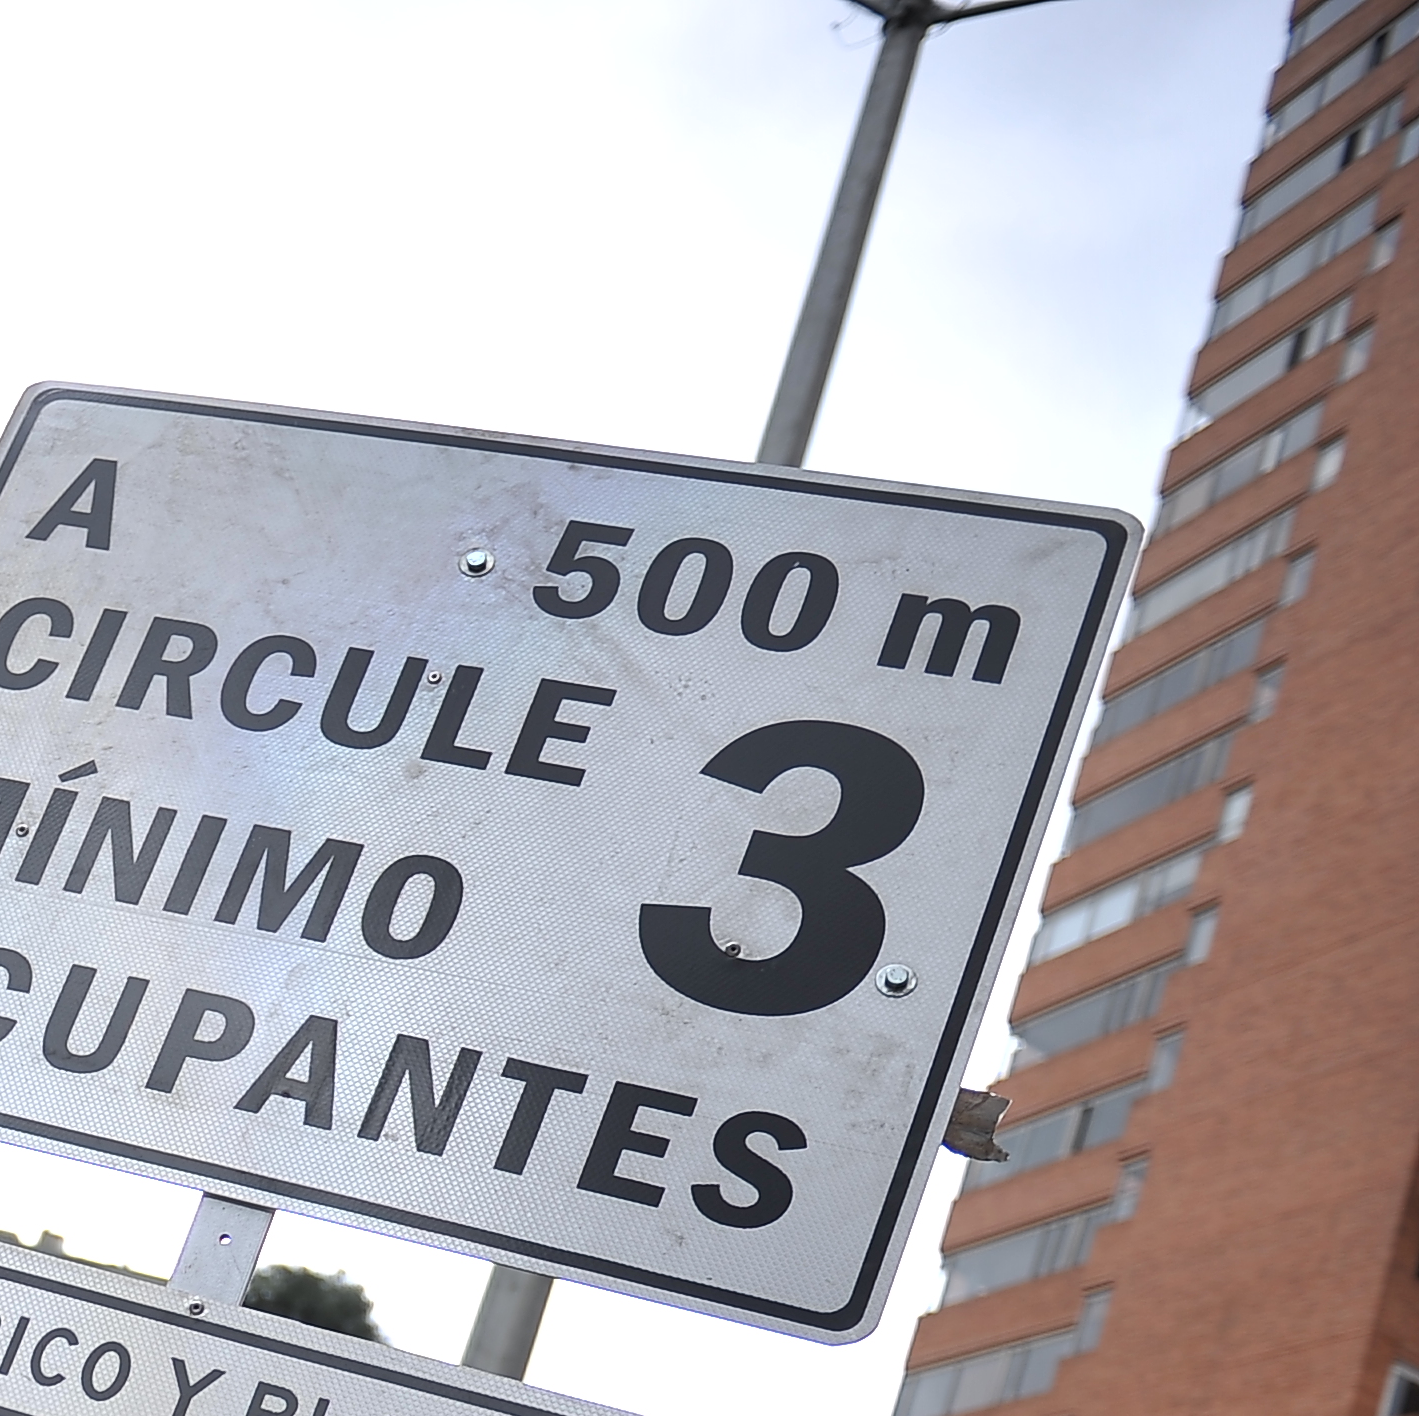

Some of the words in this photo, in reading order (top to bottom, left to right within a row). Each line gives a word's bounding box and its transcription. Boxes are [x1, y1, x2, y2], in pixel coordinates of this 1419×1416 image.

[25, 458, 118, 551] A
[532, 519, 840, 653] 500
[876, 592, 1021, 685] m
[638, 719, 926, 1017] 3
